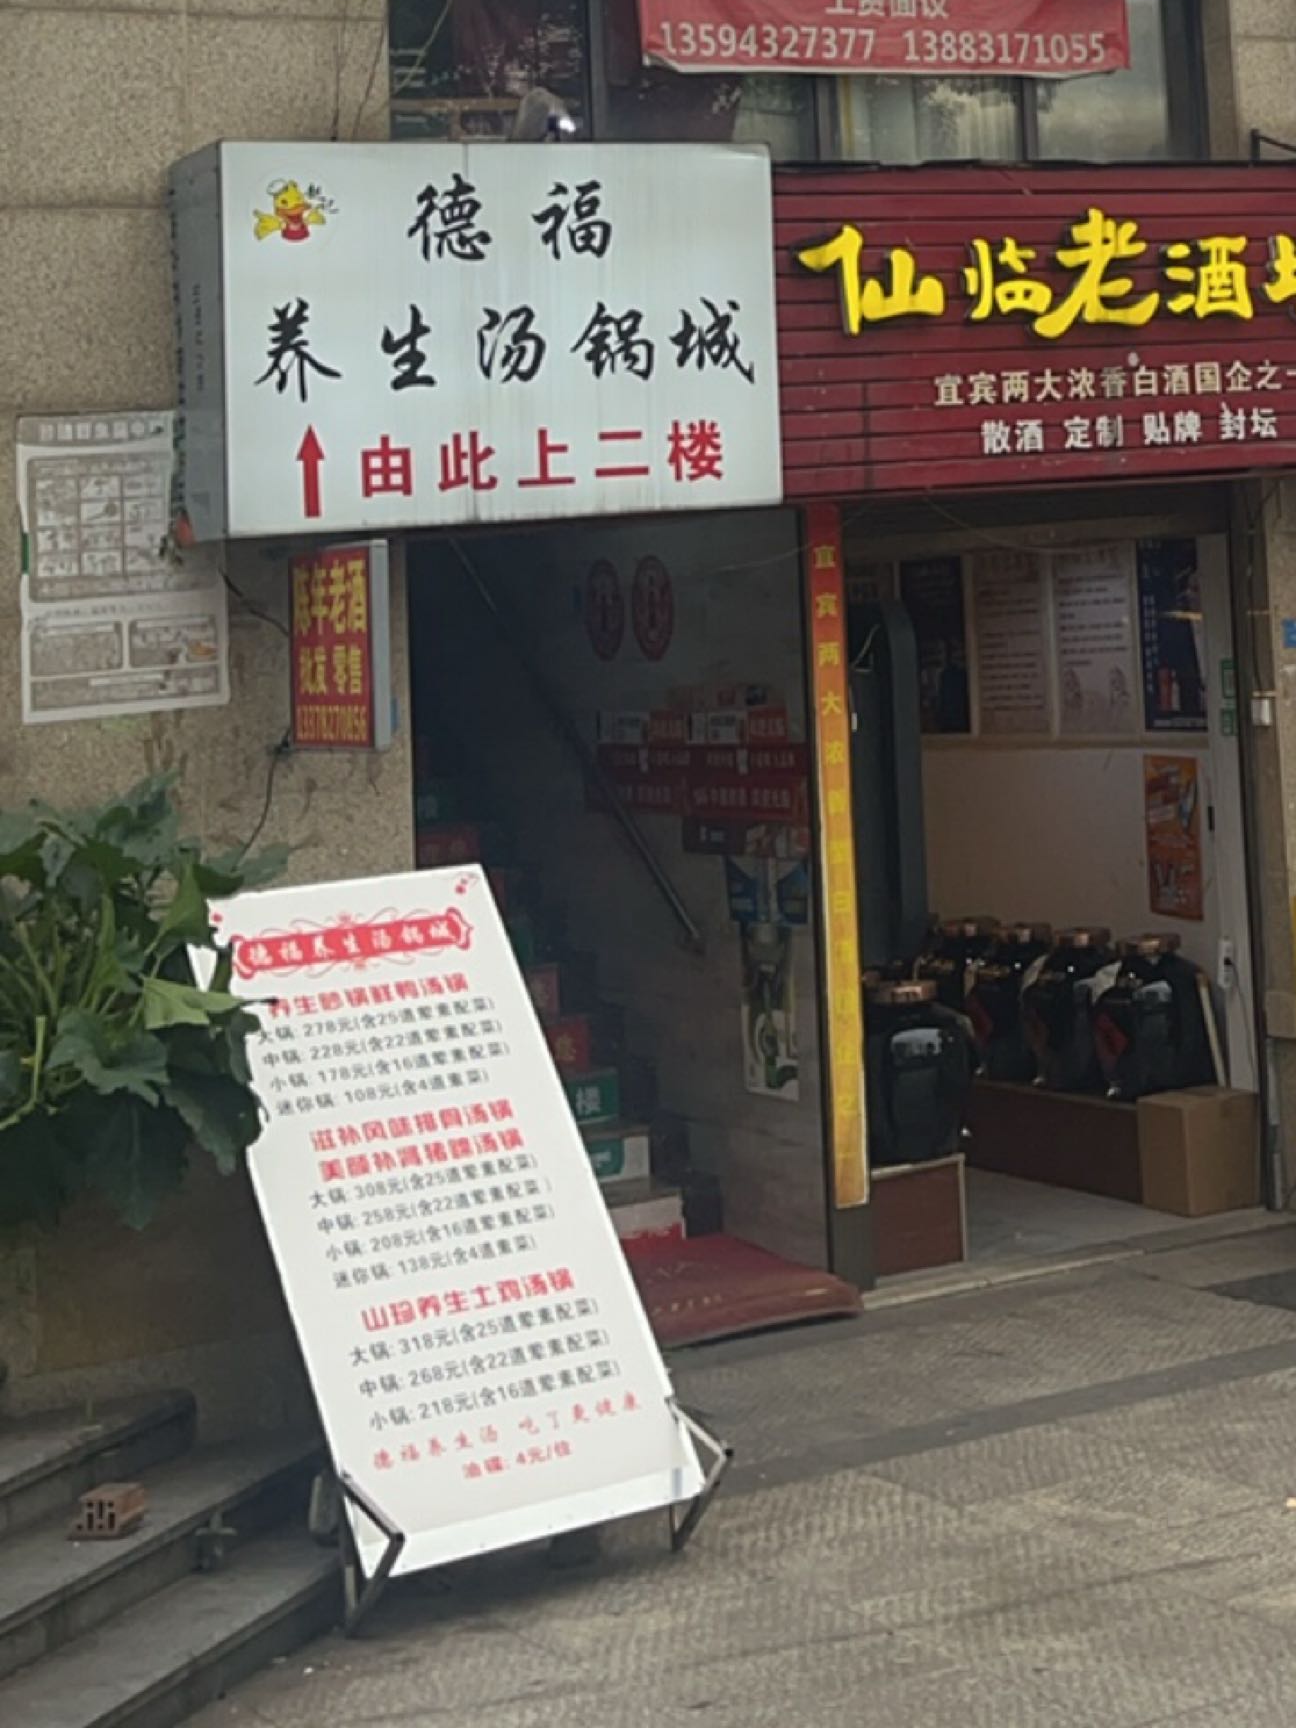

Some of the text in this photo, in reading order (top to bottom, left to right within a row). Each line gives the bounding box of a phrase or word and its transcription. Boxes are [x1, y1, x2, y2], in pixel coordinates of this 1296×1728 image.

[661, 21, 1107, 65] 13594327377 13883171055
[408, 174, 612, 260] 德福
[254, 297, 756, 402] 养生汤锅城
[360, 419, 724, 498] 由此上二楼
[981, 405, 1278, 454] 散酒 定制 贴牌 封坛
